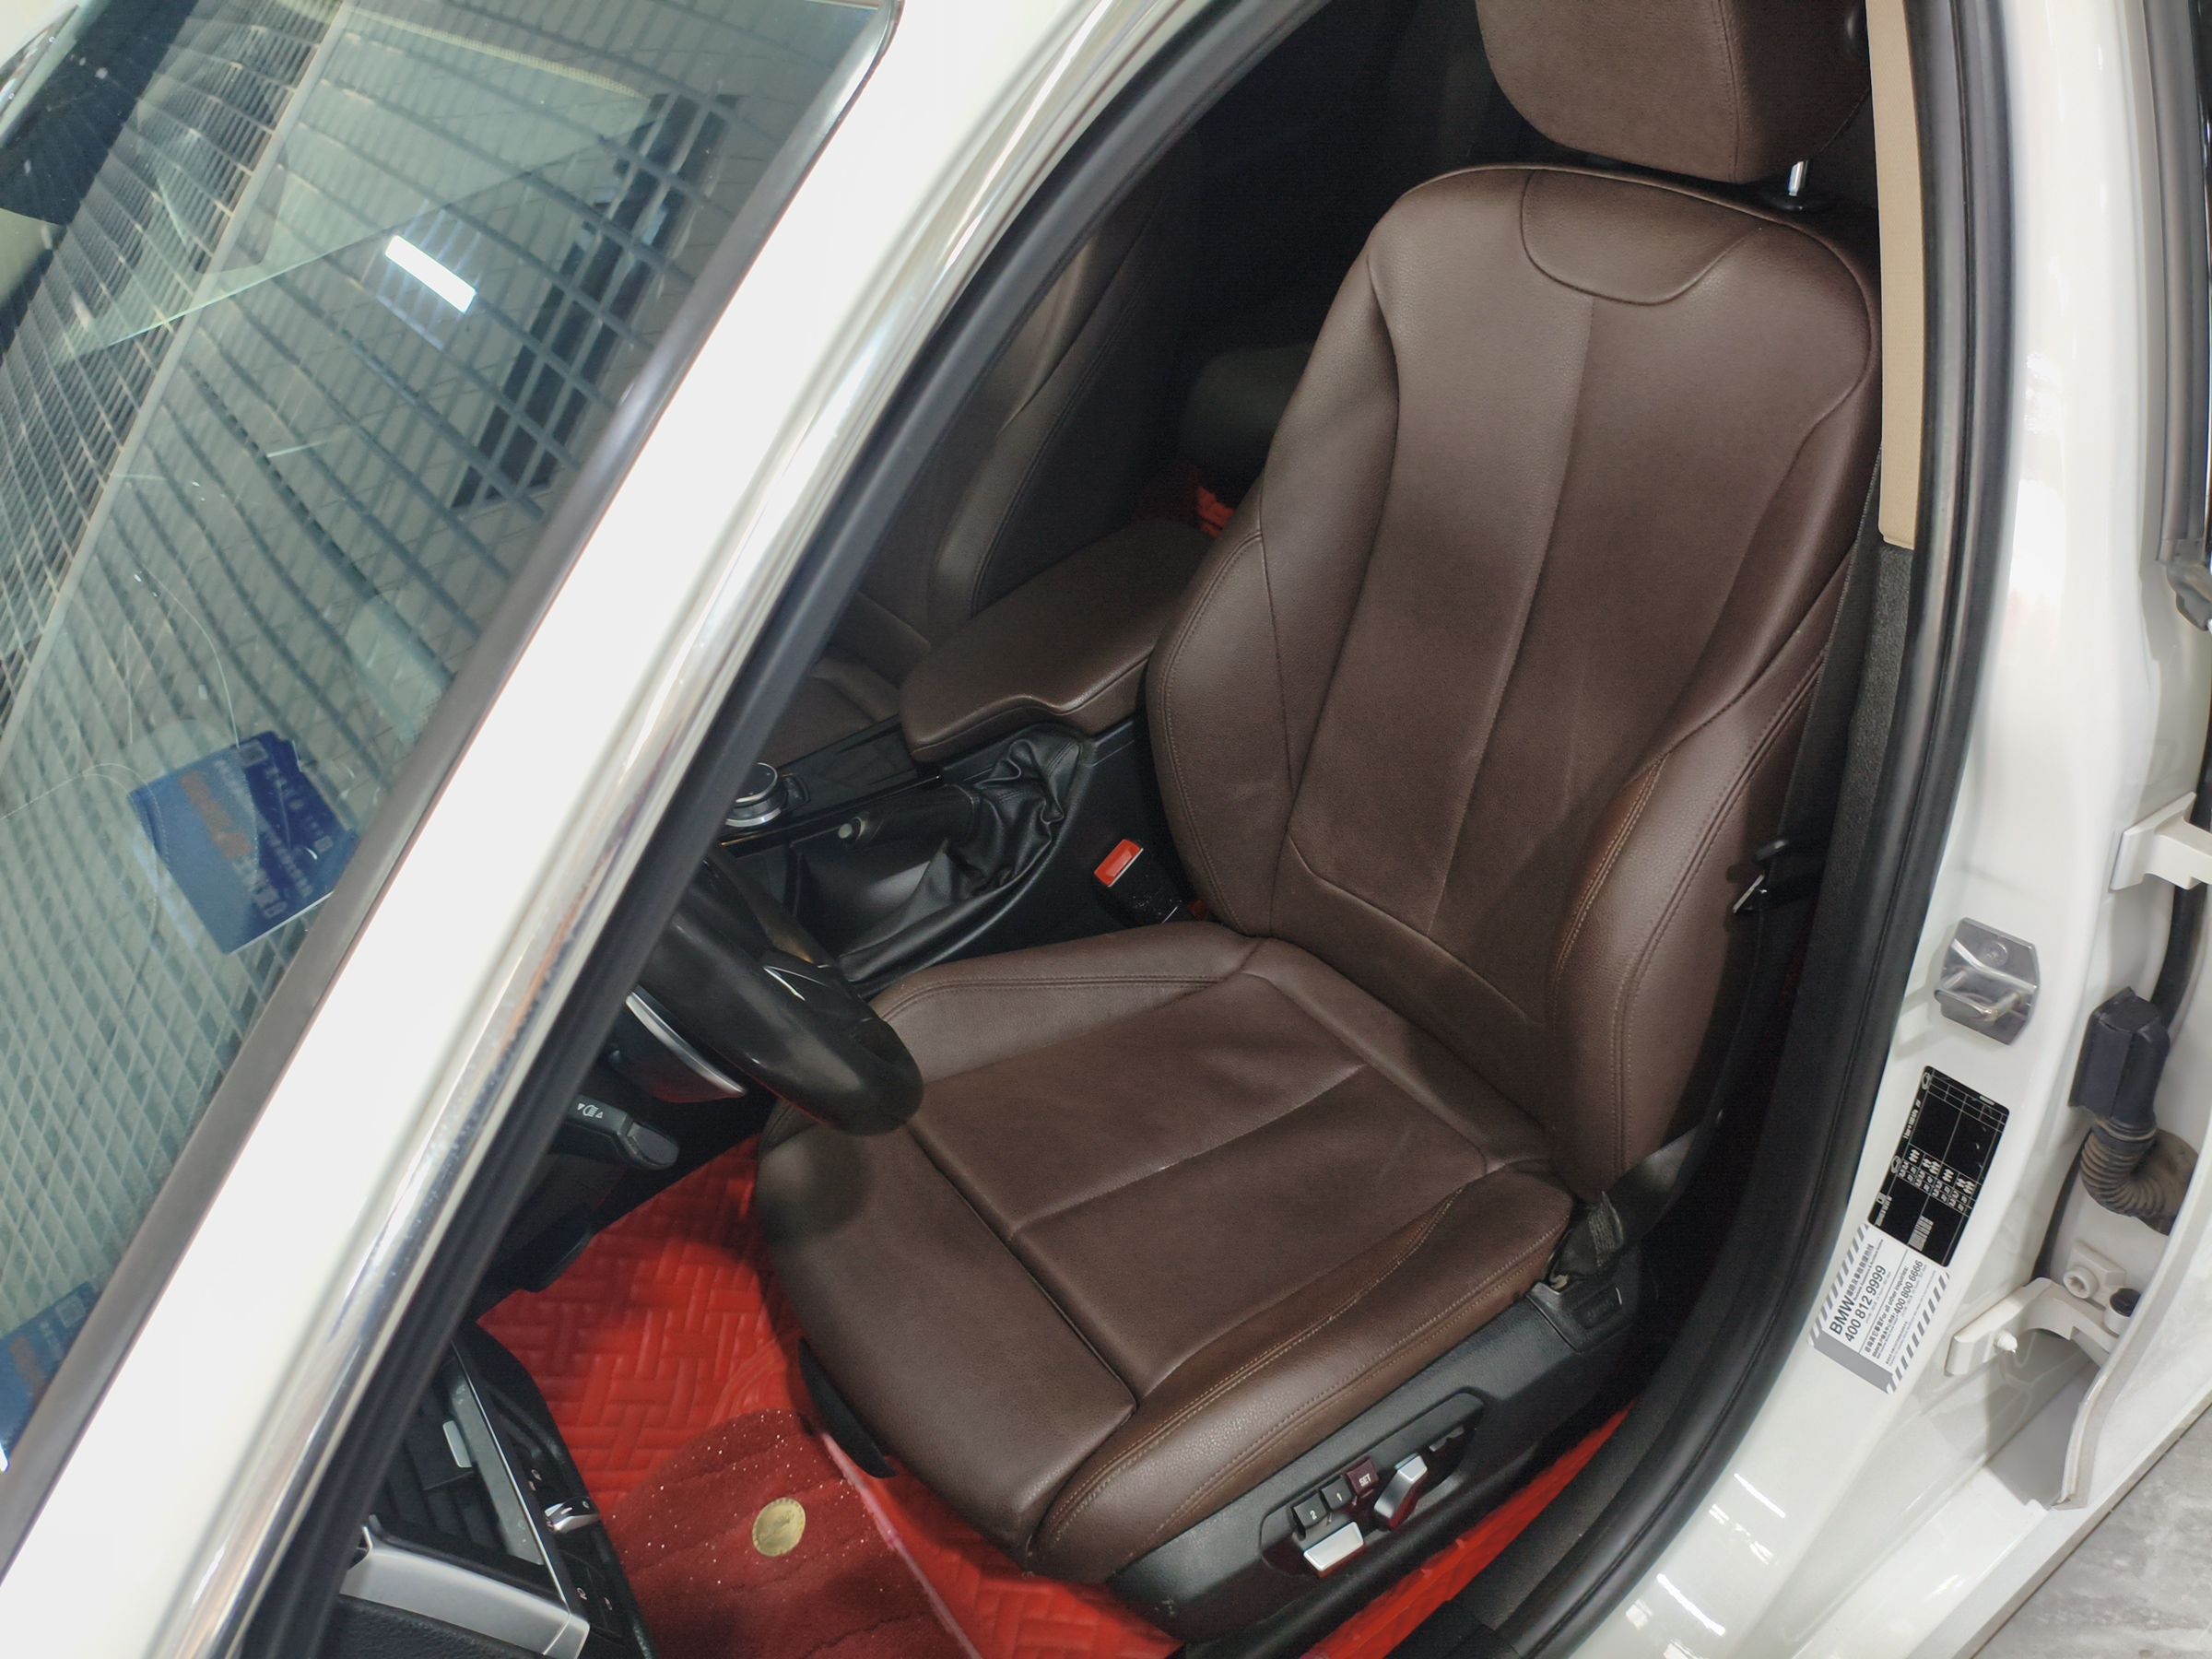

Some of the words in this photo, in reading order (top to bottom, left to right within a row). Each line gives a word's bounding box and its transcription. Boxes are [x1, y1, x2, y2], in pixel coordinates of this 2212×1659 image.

[1842, 1317, 1862, 1343] 400
[1853, 1293, 1873, 1320] 812
[1864, 1264, 1887, 1296] 9999
[1892, 1296, 1906, 1314] 400
[1829, 1294, 1855, 1335] BMW
[1359, 1473, 1371, 1488] SET
[1336, 1492, 1343, 1502] 1
[1310, 1510, 1318, 1520] 2
